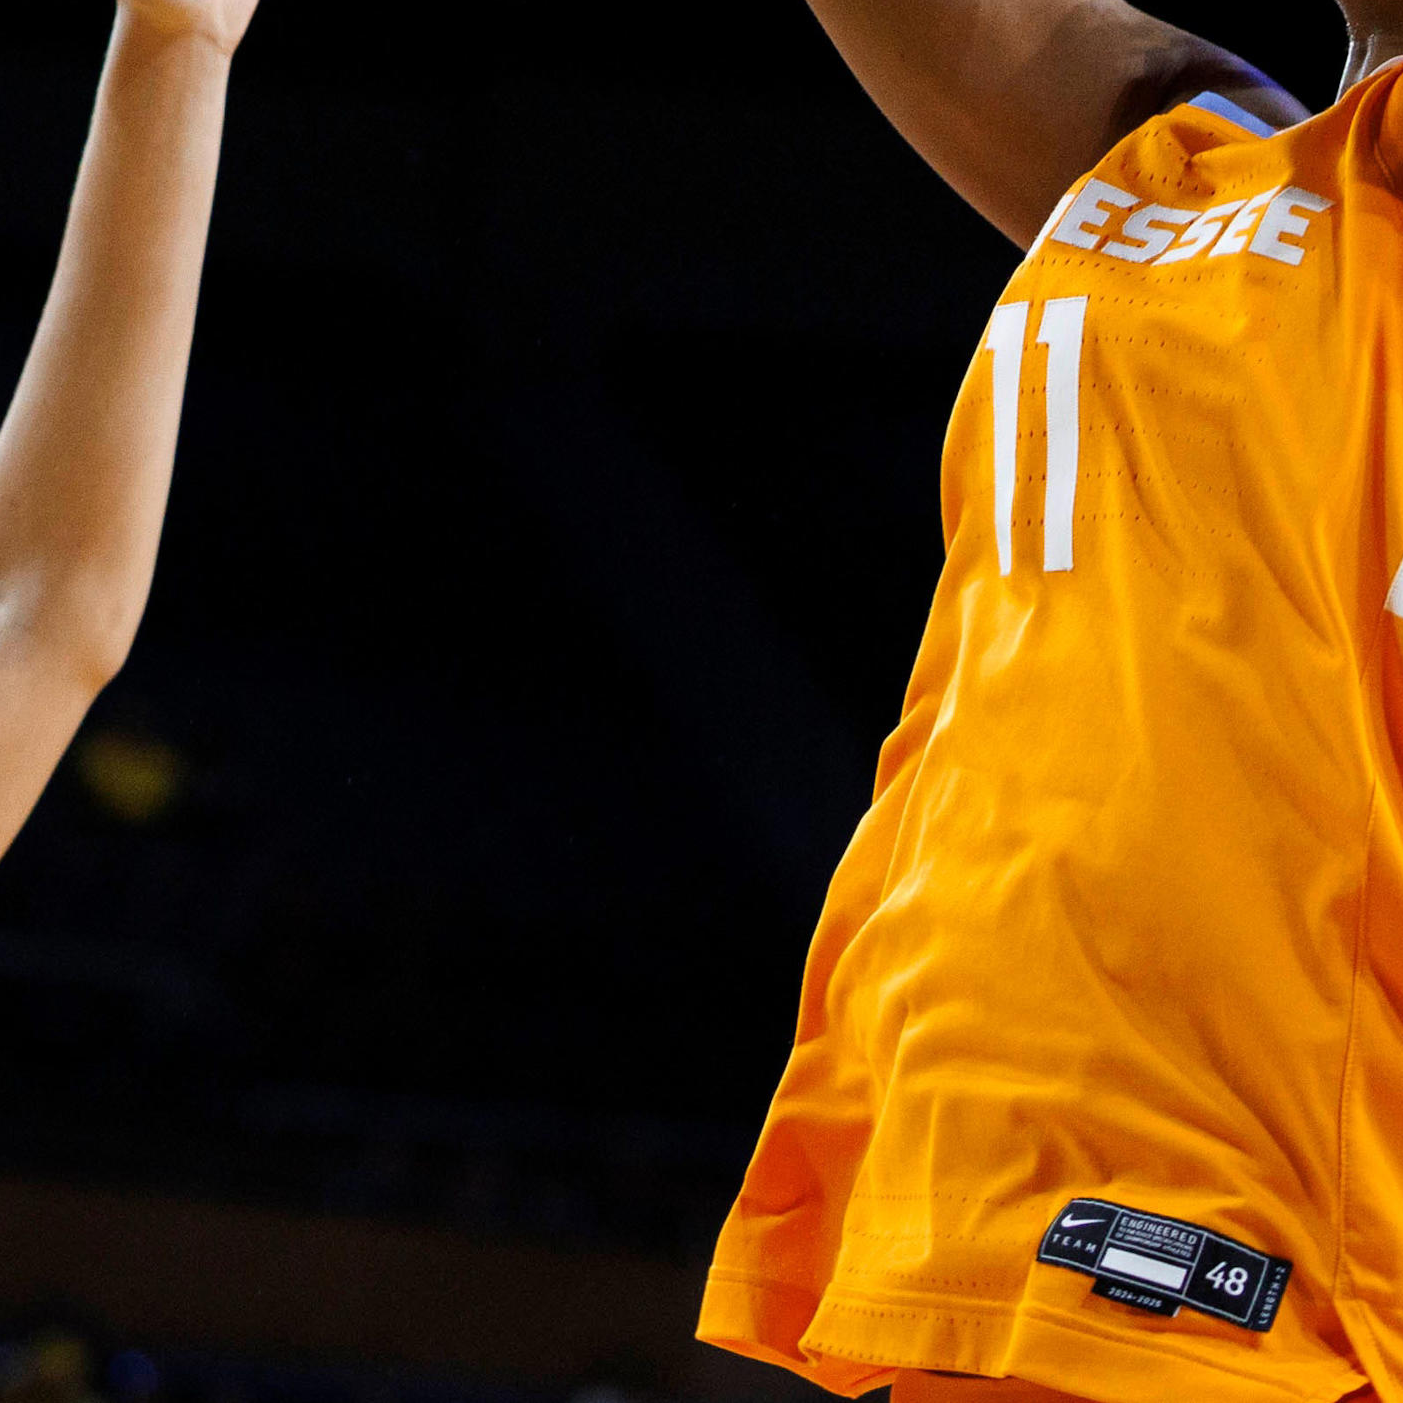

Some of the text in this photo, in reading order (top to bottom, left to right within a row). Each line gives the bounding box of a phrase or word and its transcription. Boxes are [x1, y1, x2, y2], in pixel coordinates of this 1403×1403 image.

[984, 295, 1089, 577] 11
[1051, 1233, 1097, 1254] TEAM
[1120, 1216, 1197, 1245] ENGINEERED
[1205, 1260, 1249, 1296] 48
